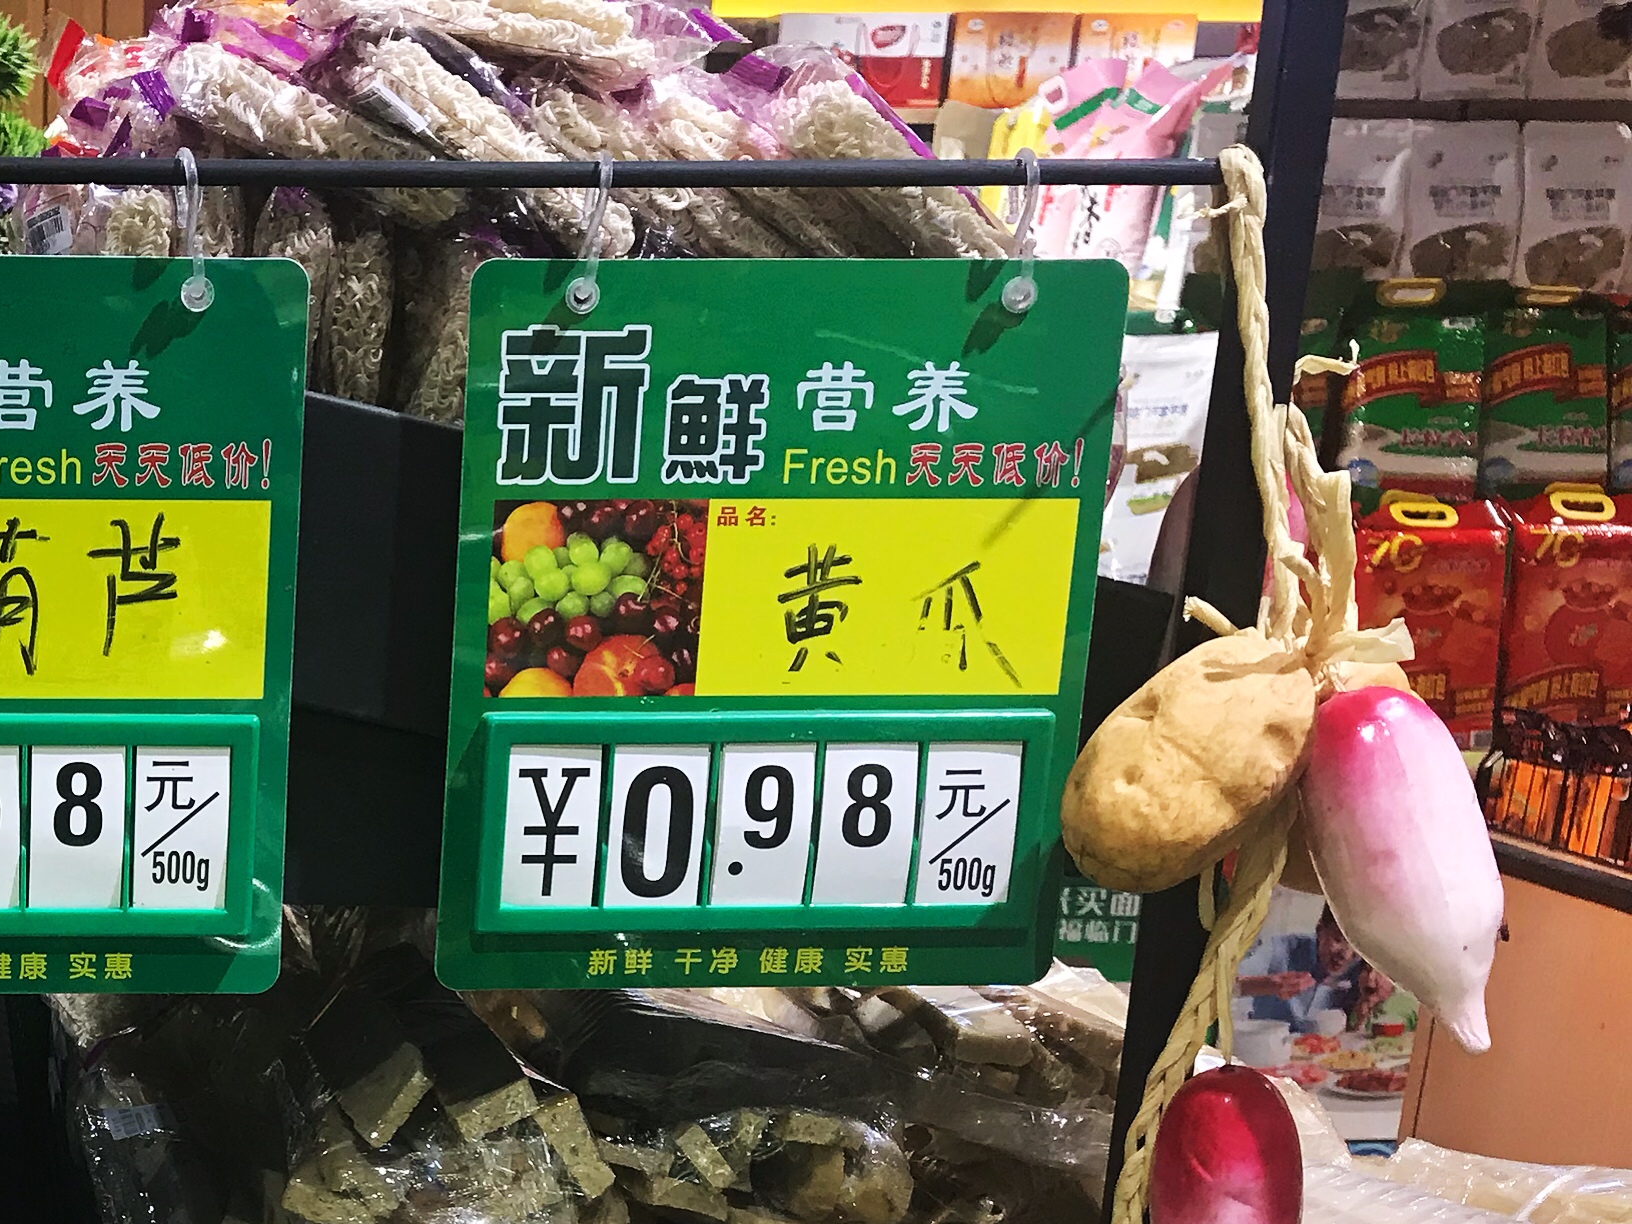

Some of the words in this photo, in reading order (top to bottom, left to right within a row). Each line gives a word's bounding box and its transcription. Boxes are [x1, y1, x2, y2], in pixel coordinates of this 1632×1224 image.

[796, 361, 979, 432] 营养
[782, 448, 895, 484] Fresh
[777, 543, 1022, 689] 黄瓜
[69, 952, 133, 979] 实惠
[588, 948, 653, 975] 新鲜
[674, 948, 739, 974] 干净
[759, 946, 823, 975] 健康
[844, 946, 909, 974] 实惠
